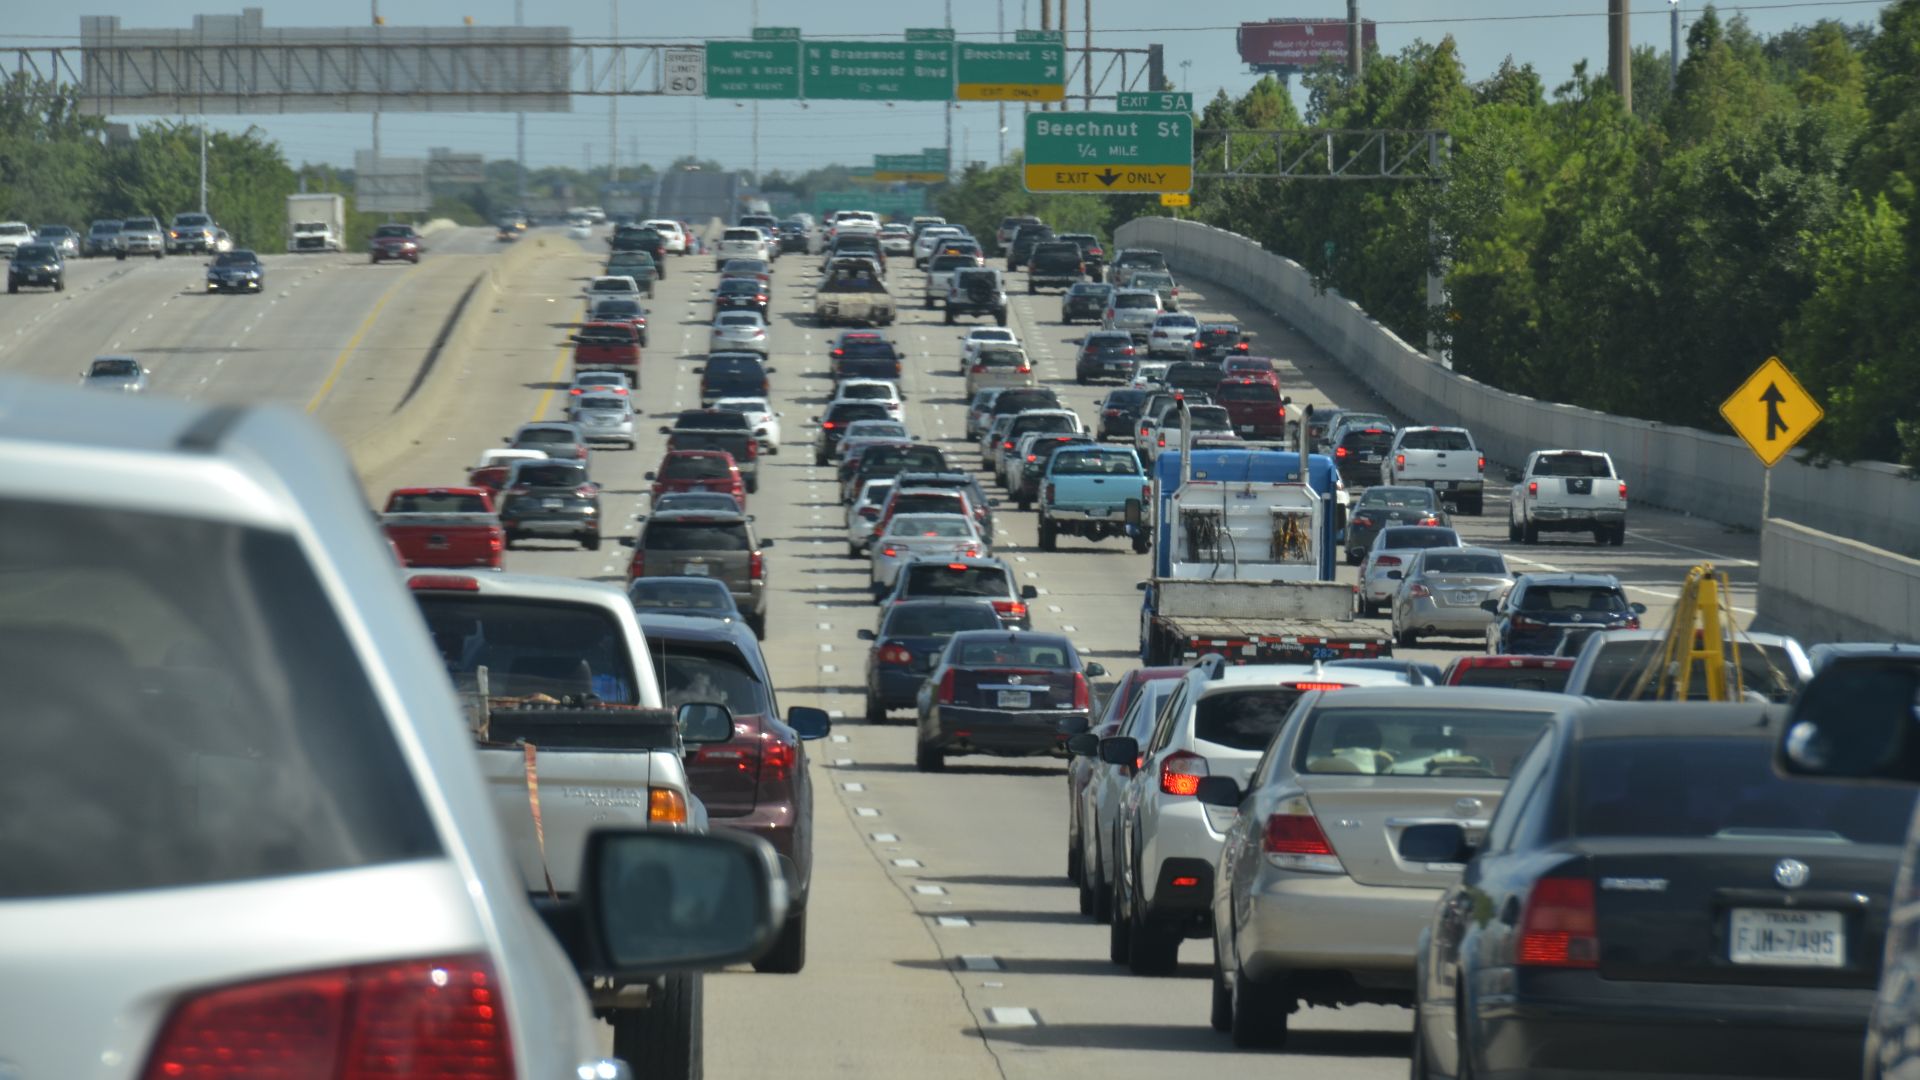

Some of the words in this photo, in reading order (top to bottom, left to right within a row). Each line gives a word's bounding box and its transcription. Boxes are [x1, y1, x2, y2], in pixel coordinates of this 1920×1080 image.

[669, 54, 700, 62] SPEED
[809, 48, 821, 59] N
[913, 49, 948, 61] Blvd
[963, 48, 1031, 61] Beechnut
[1041, 49, 1058, 61] St
[671, 64, 697, 72] LIMIT
[764, 65, 794, 75] RIDE
[810, 65, 820, 76] S
[913, 65, 948, 77] Blvd
[671, 76, 697, 91] 60
[1121, 96, 1149, 107] EXIT
[1160, 95, 1188, 109] 5A
[1036, 120, 1138, 136] Beechnut
[1157, 121, 1180, 137] St
[1109, 146, 1139, 156] MILE
[1055, 172, 1089, 184] EXIT
[1126, 172, 1167, 184] ONLY
[1766, 911, 1808, 924] TEXAS
